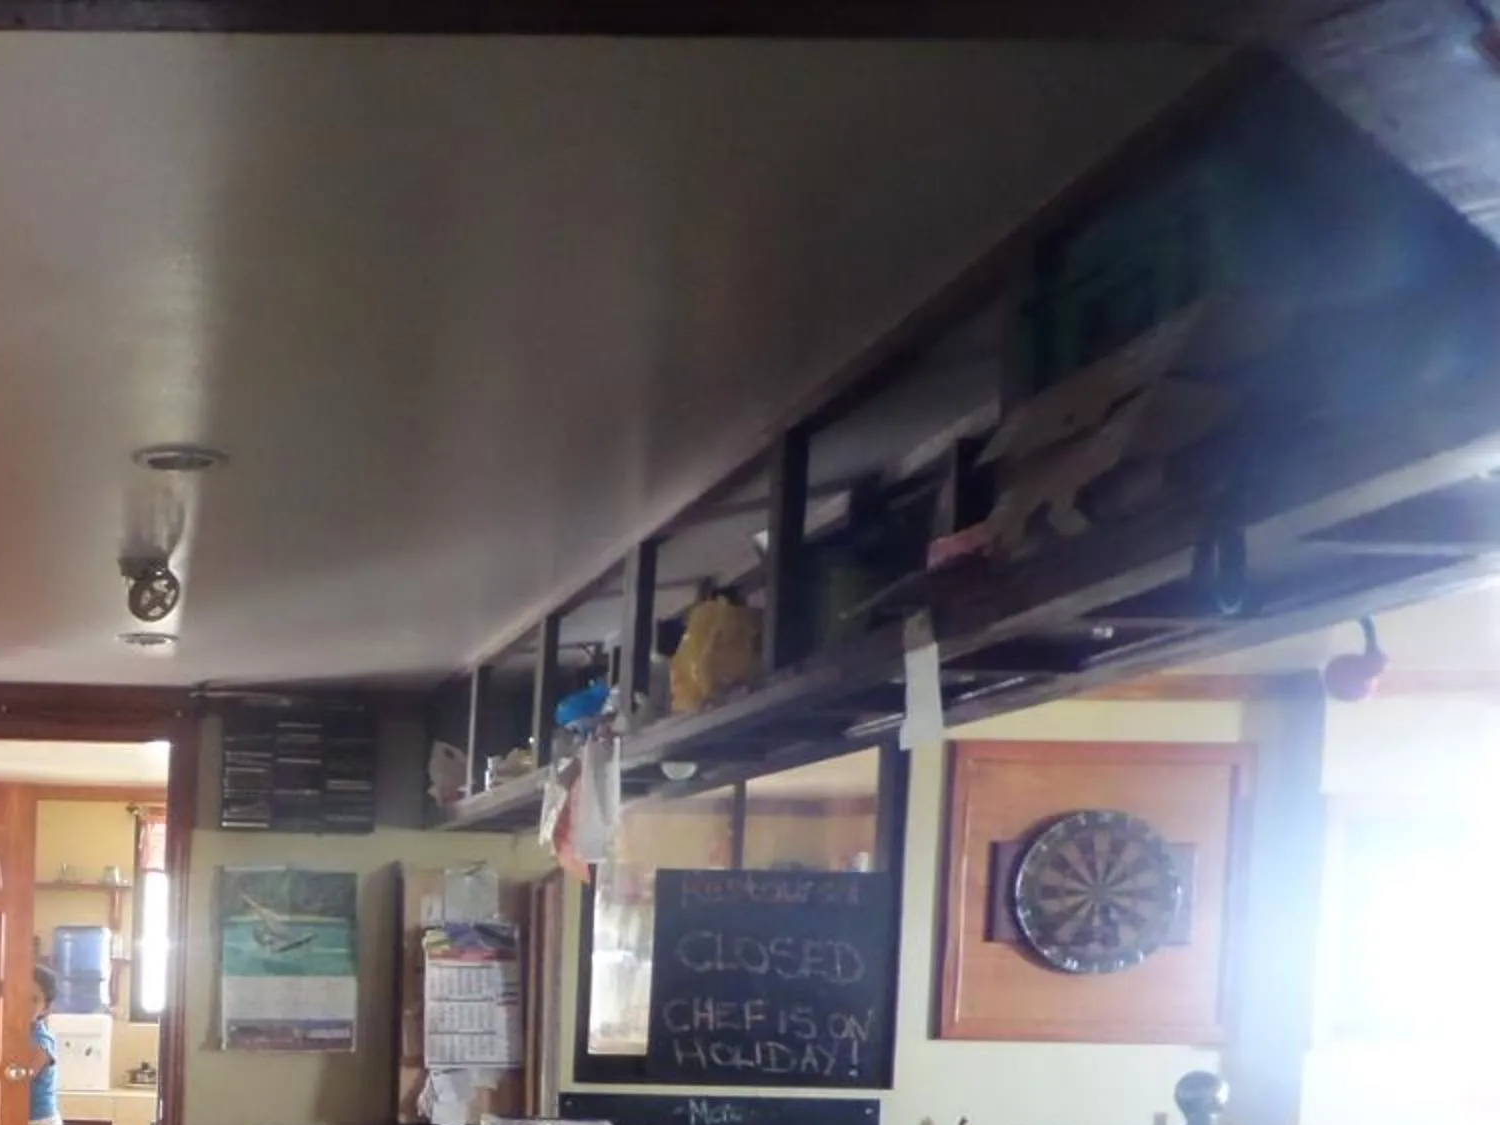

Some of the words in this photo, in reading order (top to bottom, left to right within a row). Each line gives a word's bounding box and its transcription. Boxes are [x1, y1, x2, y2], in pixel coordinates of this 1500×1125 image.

[678, 932, 865, 984] CLOSED
[663, 998, 765, 1032] CHEF
[778, 1007, 817, 1039] IS
[829, 1009, 872, 1042] ON
